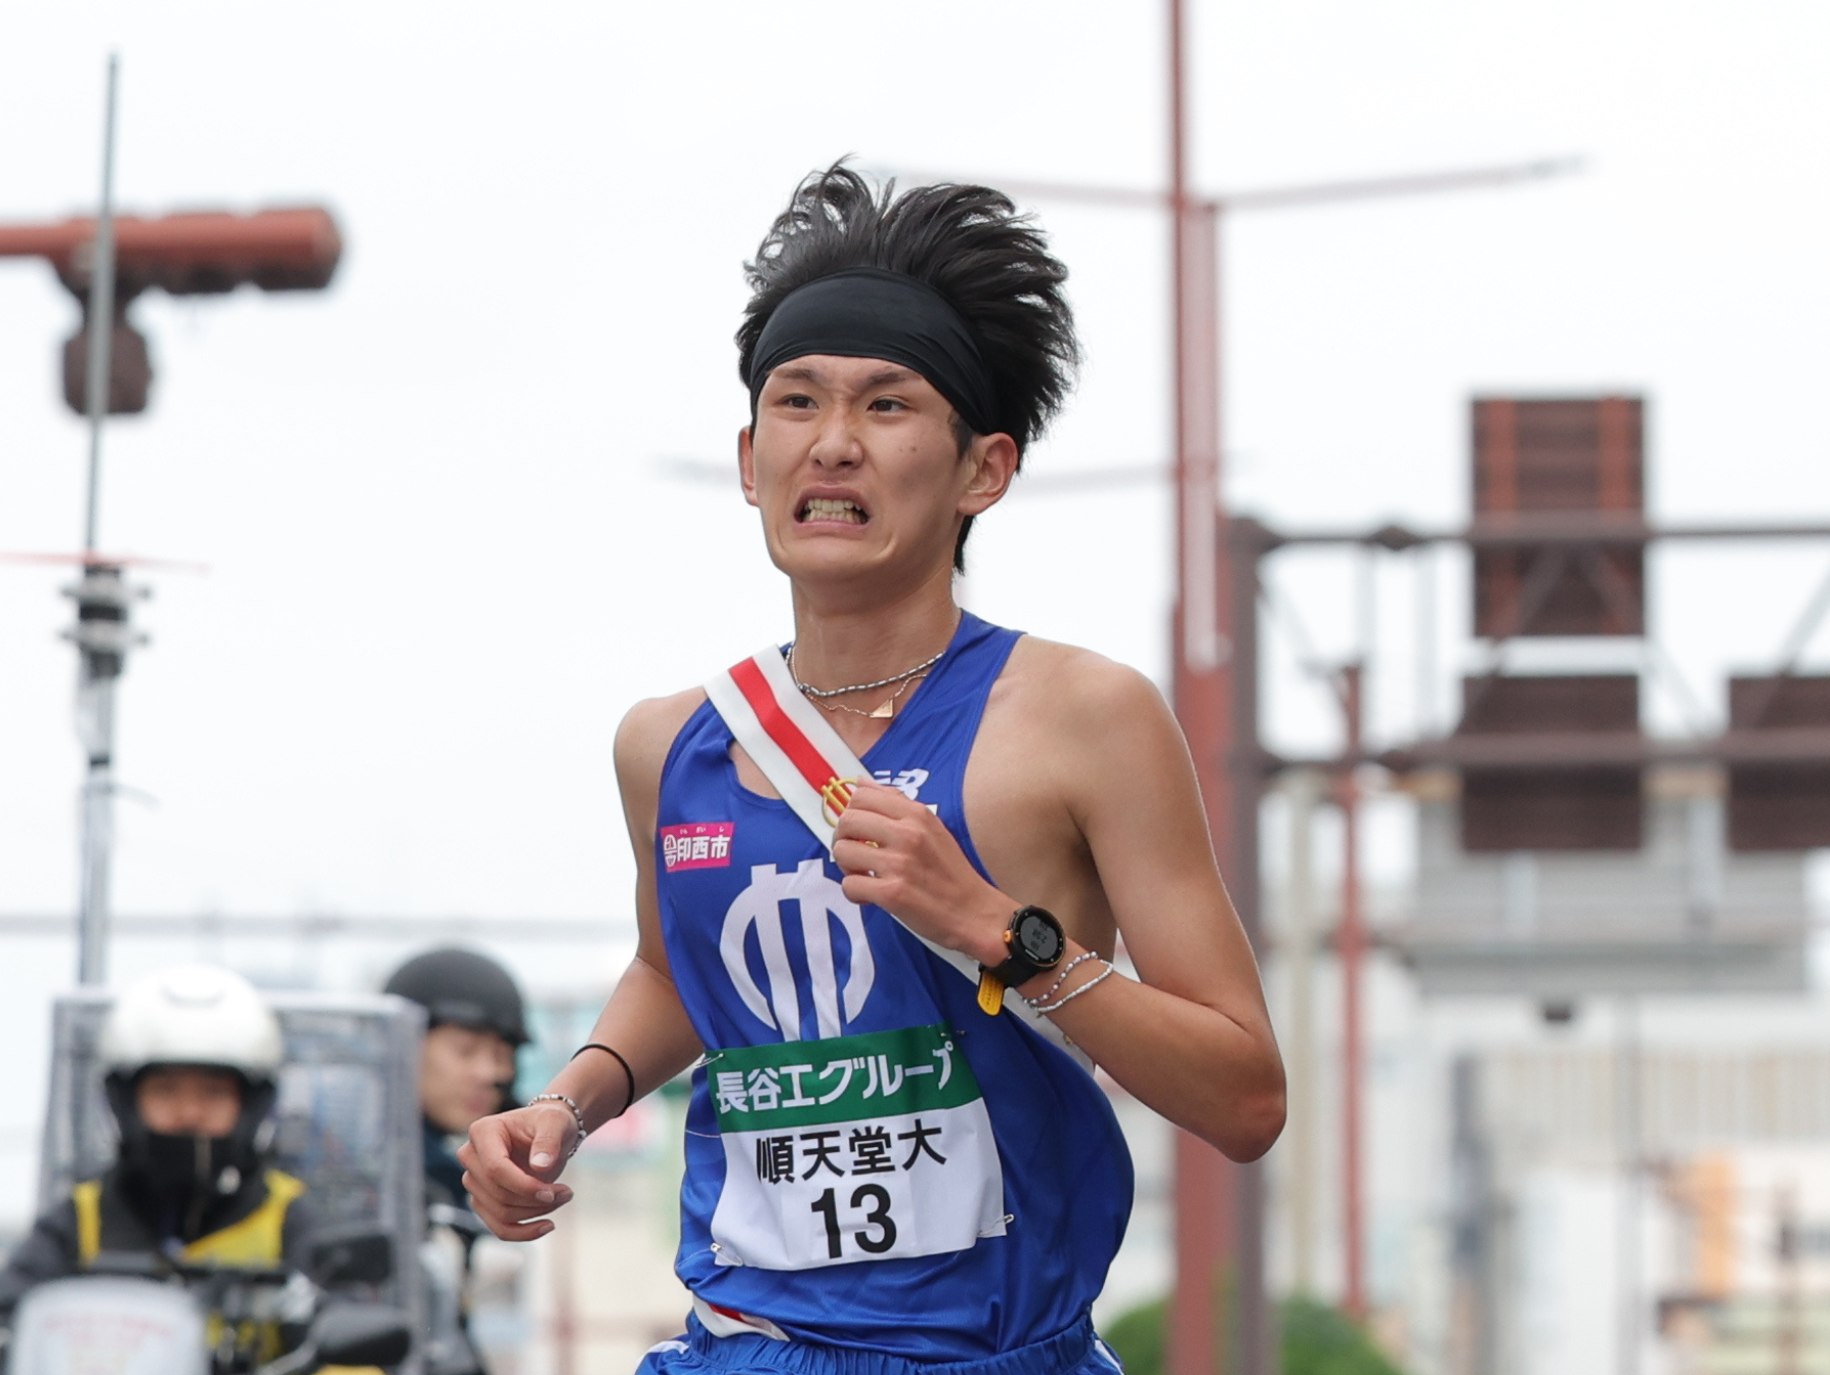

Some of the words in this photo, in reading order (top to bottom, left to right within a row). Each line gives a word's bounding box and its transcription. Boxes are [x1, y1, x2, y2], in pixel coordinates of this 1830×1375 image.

[677, 834, 731, 862] 印西市
[716, 1041, 954, 1114] 長谷工グループ
[756, 1118, 947, 1185] 順天堂大
[810, 1183, 897, 1260] 13
